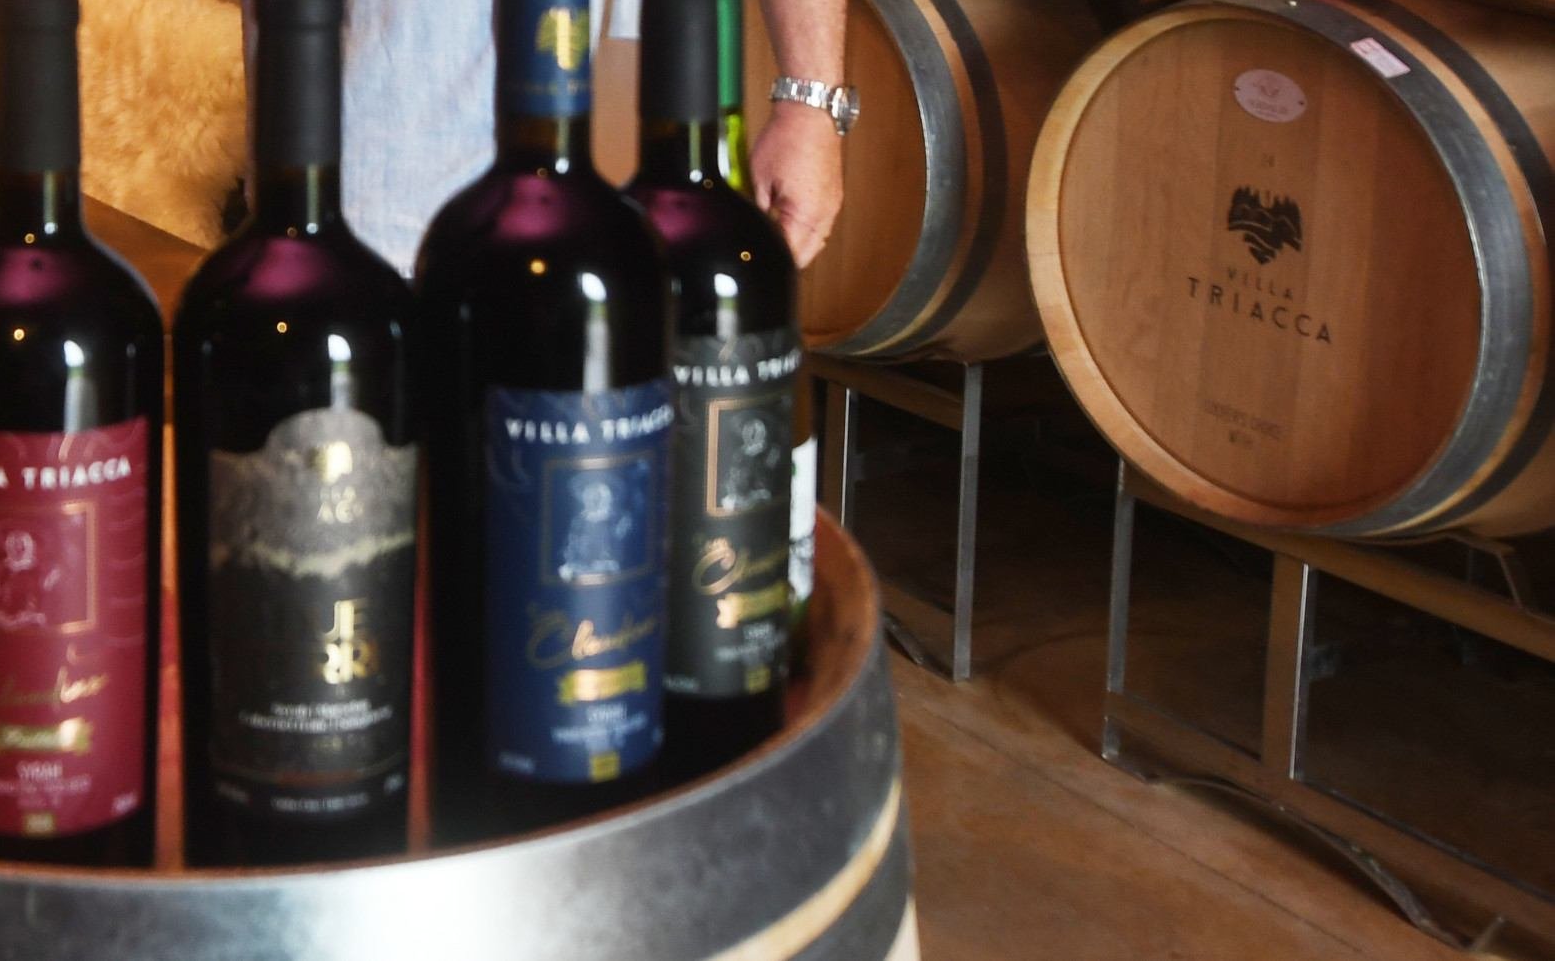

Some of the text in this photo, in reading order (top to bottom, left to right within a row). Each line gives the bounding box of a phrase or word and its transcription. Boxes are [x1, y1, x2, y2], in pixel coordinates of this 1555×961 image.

[1227, 266, 1294, 301] VILLA
[1188, 276, 1332, 345] TRIACCA
[672, 364, 750, 388] VILLA
[505, 417, 591, 445] VILLA
[21, 455, 131, 490] TRIACCA
